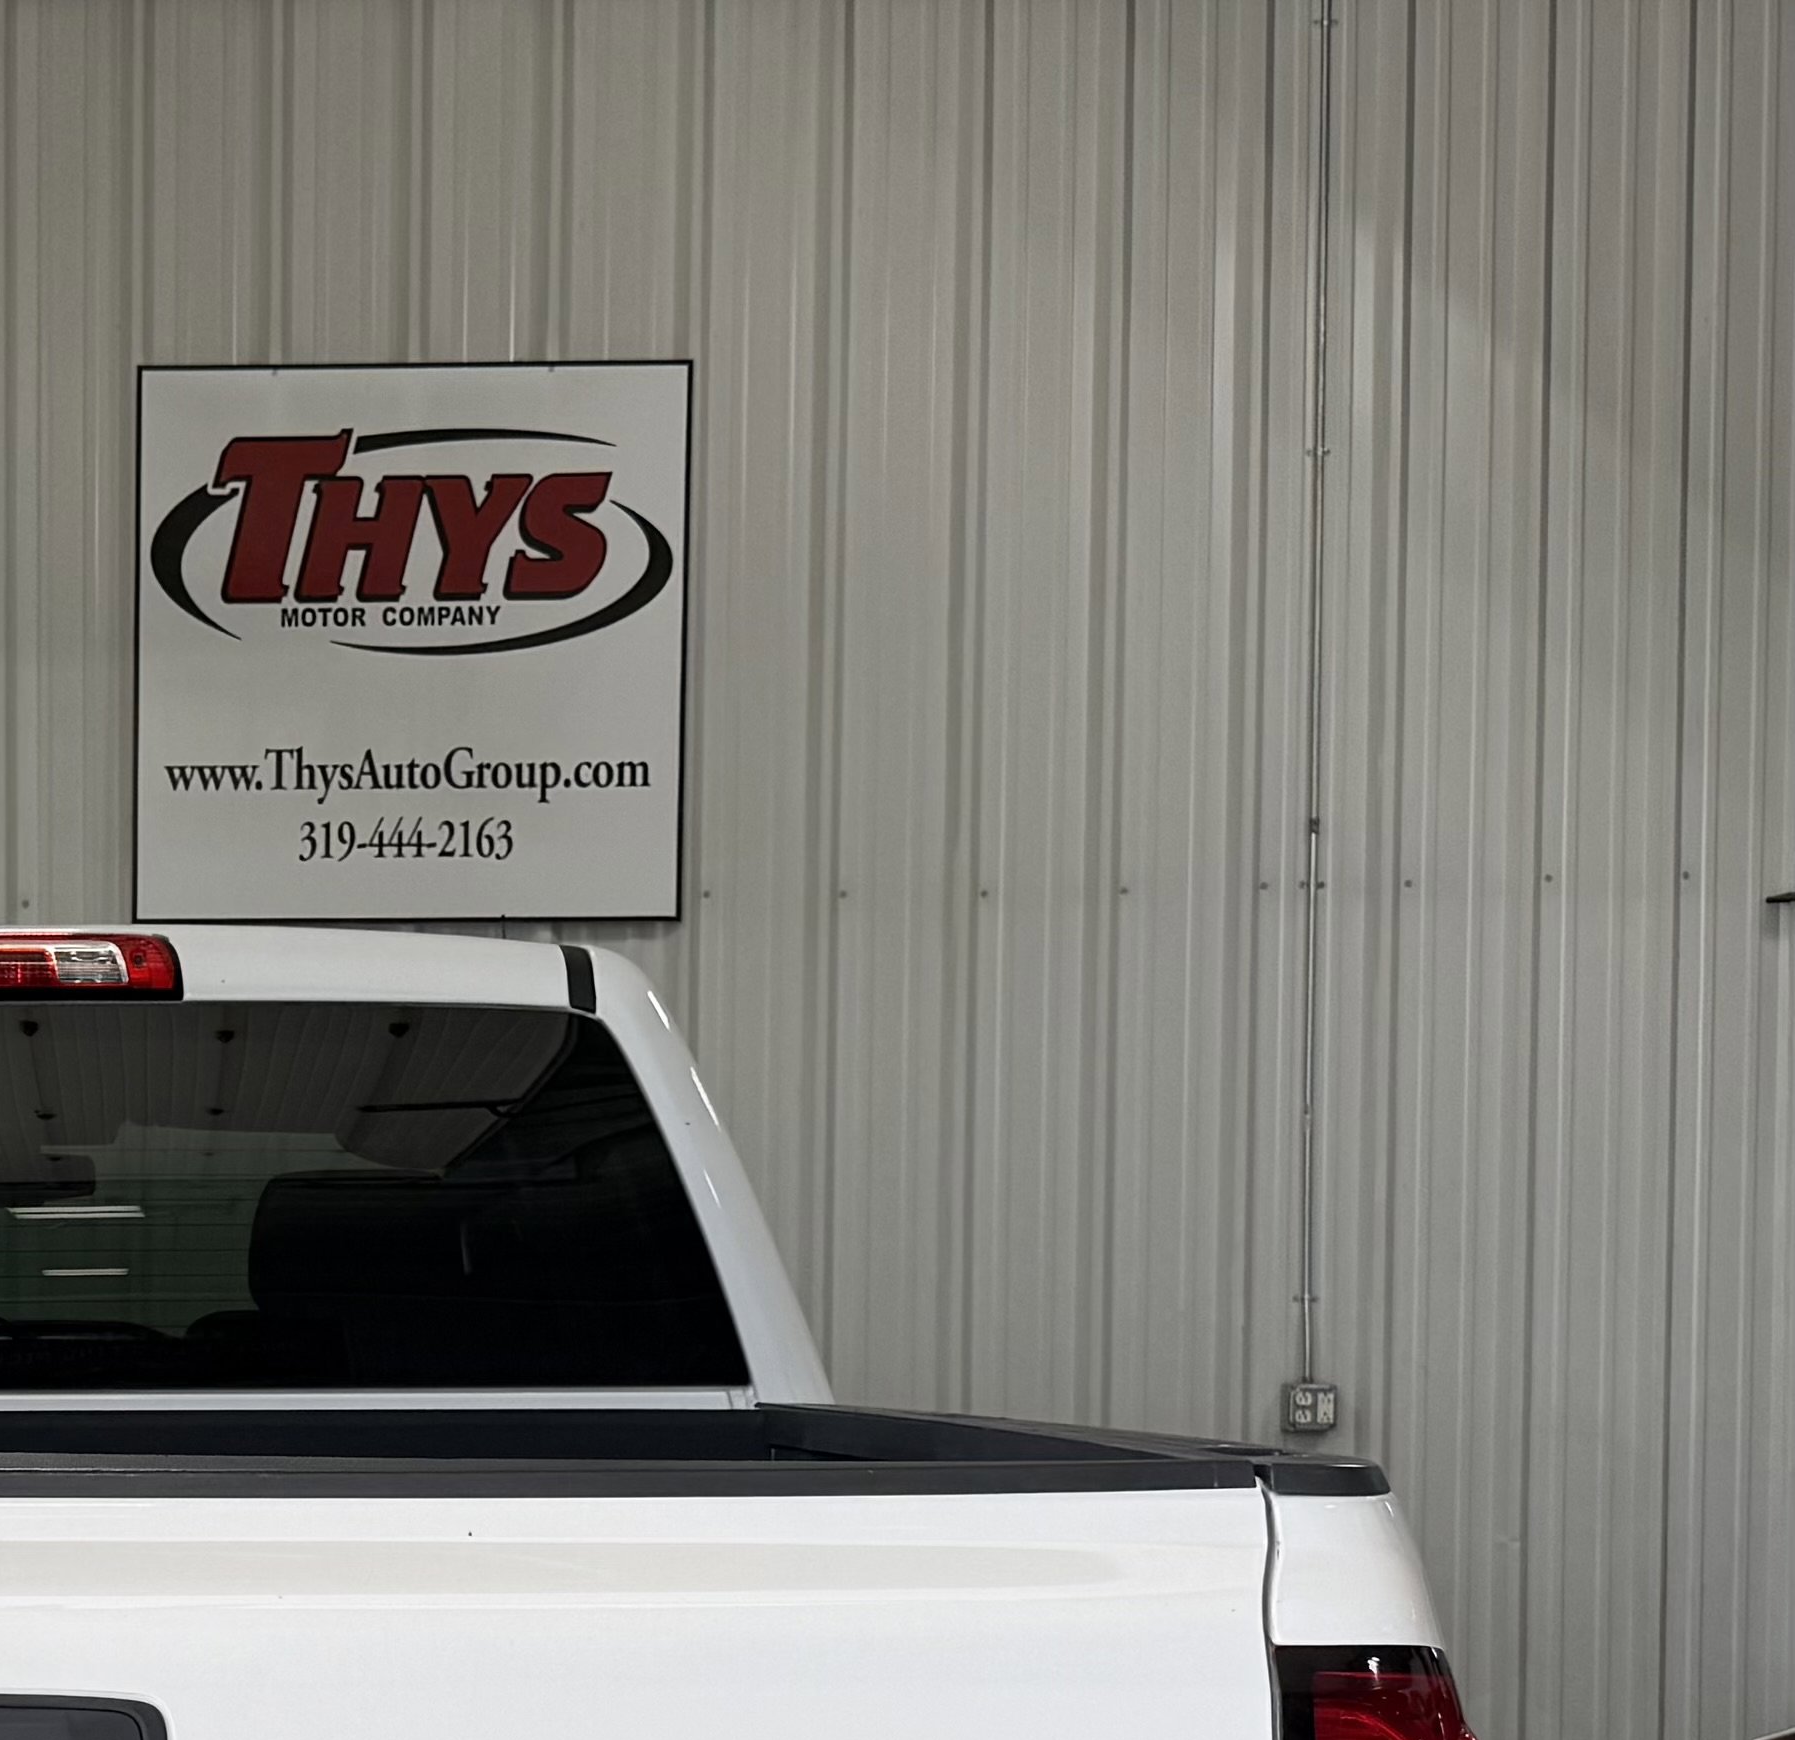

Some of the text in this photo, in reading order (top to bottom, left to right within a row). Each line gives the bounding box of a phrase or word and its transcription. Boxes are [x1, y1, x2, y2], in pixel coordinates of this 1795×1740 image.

[211, 427, 614, 605] THYS
[279, 605, 503, 628] MOTOR COMPANY
[163, 746, 652, 805] www.ThysAutoGroup.com
[297, 816, 515, 862] 319-444-2163
